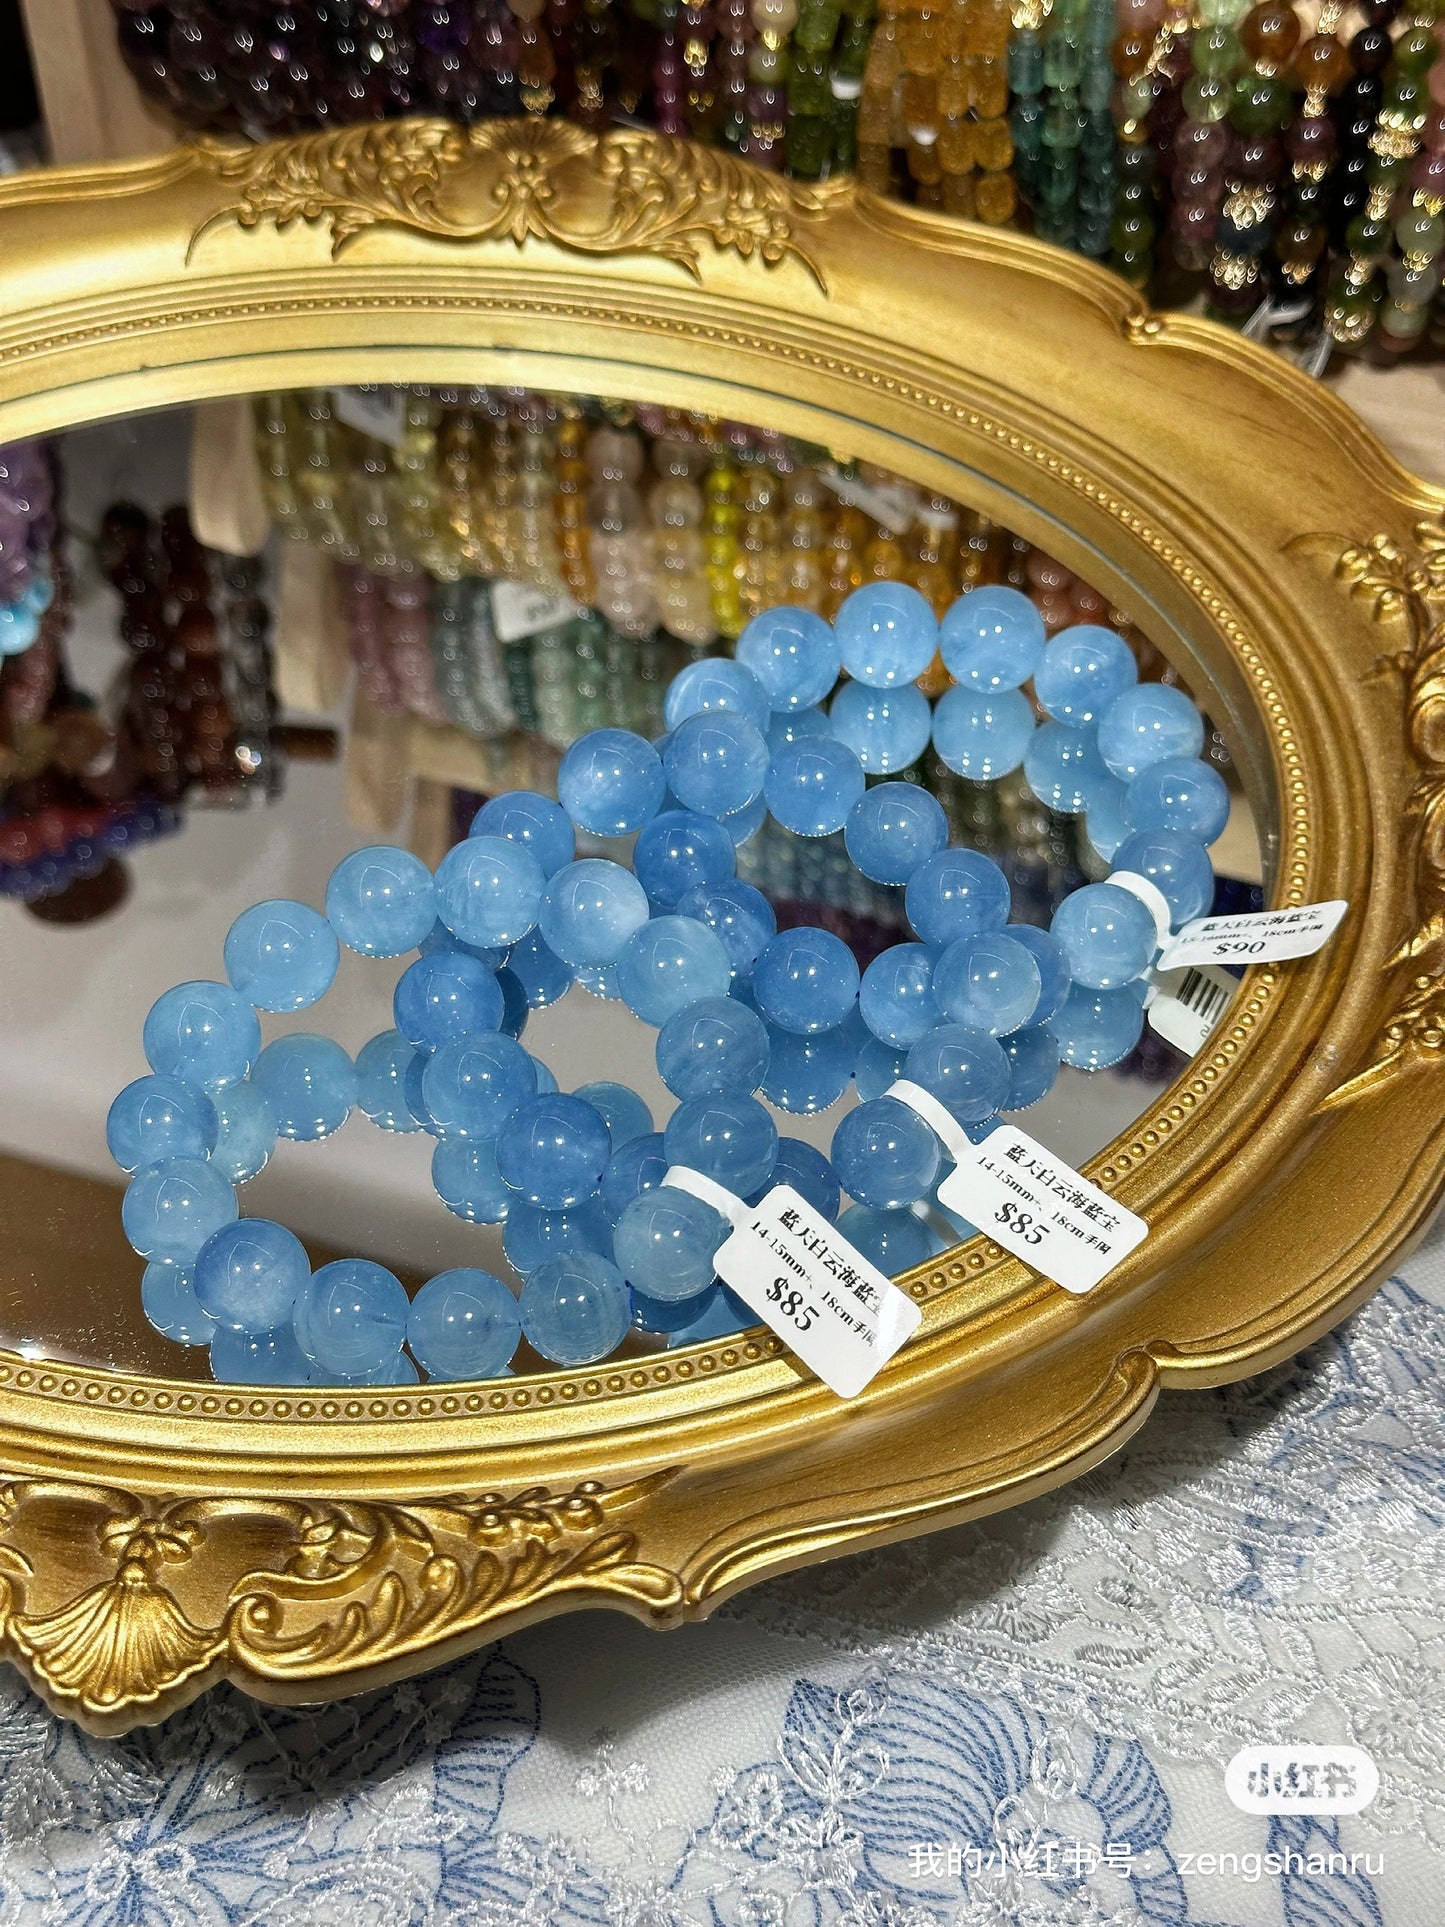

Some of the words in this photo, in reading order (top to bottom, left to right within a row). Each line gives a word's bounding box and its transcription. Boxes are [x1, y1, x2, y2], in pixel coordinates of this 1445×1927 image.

[1213, 941, 1266, 955] $90
[1003, 1142, 1120, 1233] 蓝天白云海蓝宝
[994, 1201, 1051, 1246] $85
[766, 1276, 820, 1332] $85
